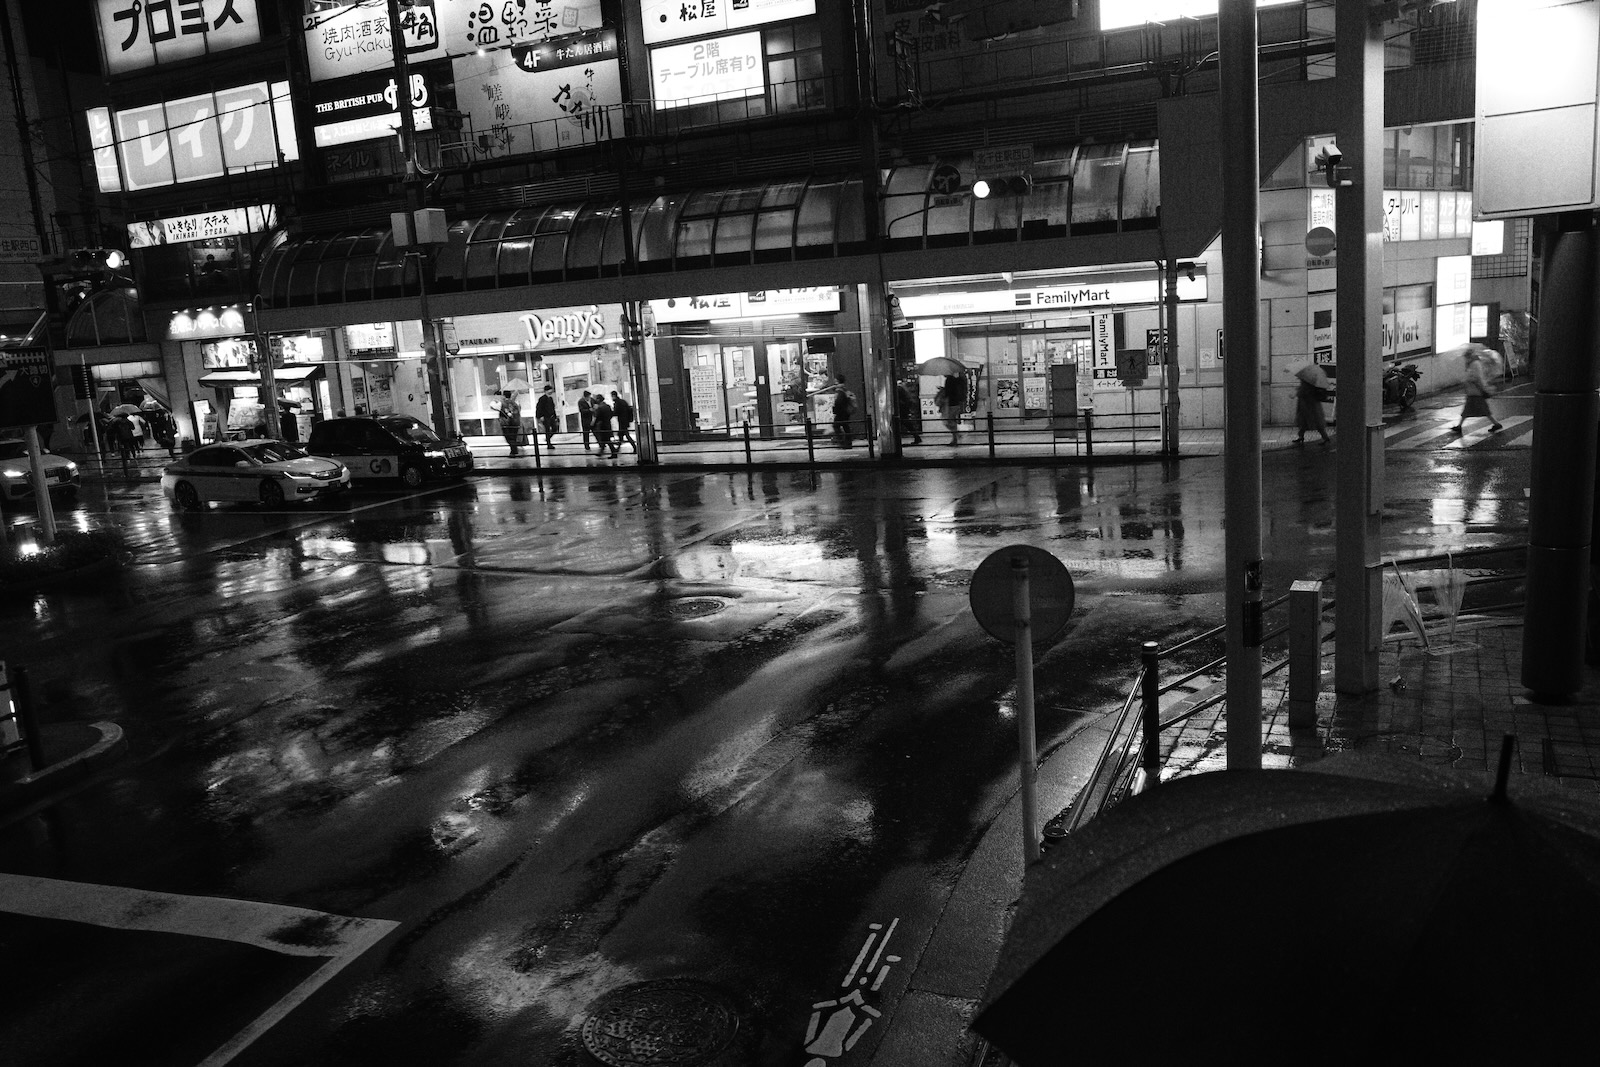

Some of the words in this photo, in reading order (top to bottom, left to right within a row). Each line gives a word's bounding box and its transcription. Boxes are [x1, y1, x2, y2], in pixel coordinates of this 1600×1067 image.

[305, 16, 321, 31] 2F
[467, 0, 558, 44] 温野菜
[679, 0, 717, 22] 松屋
[113, 0, 244, 52] プロミス
[322, 17, 390, 45] 焼肉酒家
[401, 11, 434, 40] 牛角
[324, 38, 392, 62] Gyu-Kaku
[524, 50, 541, 68] 4F
[556, 40, 612, 60] 牛たん居酒屋
[693, 41, 720, 61] 2階
[660, 55, 757, 83] テーブル席有り
[315, 102, 333, 113] THE
[334, 95, 366, 110] BRITISH
[366, 92, 384, 104] PUB
[137, 98, 254, 167] レイク
[167, 217, 197, 233] いきなり
[203, 214, 230, 228] ステーキ
[204, 227, 228, 237] STEAK
[1036, 289, 1110, 304] FamilyMart
[518, 305, 605, 349] Denny's
[1098, 314, 1109, 366] FamilyMart
